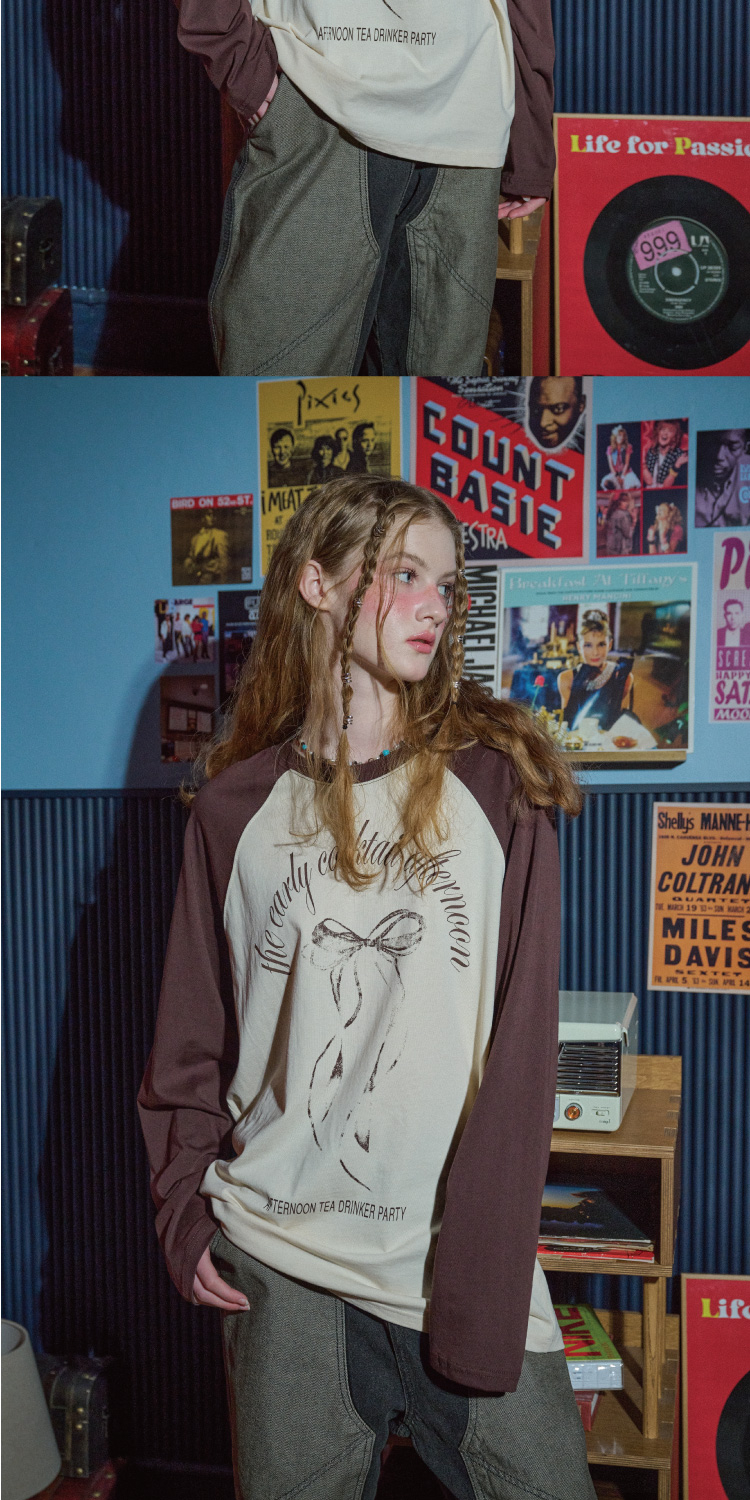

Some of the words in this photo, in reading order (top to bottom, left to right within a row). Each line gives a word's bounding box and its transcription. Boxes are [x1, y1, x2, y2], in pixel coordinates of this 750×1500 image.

[356, 27, 372, 42] TEA
[373, 28, 409, 43] DRINKER
[410, 31, 437, 46] PARTY
[570, 134, 621, 154] Life
[627, 135, 669, 155] for
[640, 230, 682, 262] 999
[296, 379, 361, 426] Pixies
[423, 400, 576, 503] COUNT
[172, 498, 195, 510] BIRD
[199, 497, 214, 508] ON
[430, 451, 562, 550] BASIE
[462, 519, 509, 551] ESTRA
[681, 844, 745, 867] JOHN
[269, 851, 316, 929] early
[686, 904, 698, 912] 19
[662, 917, 750, 942] MILES
[254, 929, 293, 976] the
[664, 944, 750, 969] DAVIS
[675, 969, 742, 977] SEXTET
[319, 1200, 335, 1213] TEA
[337, 1199, 376, 1221] DRINKER
[377, 1206, 407, 1222] PARTY
